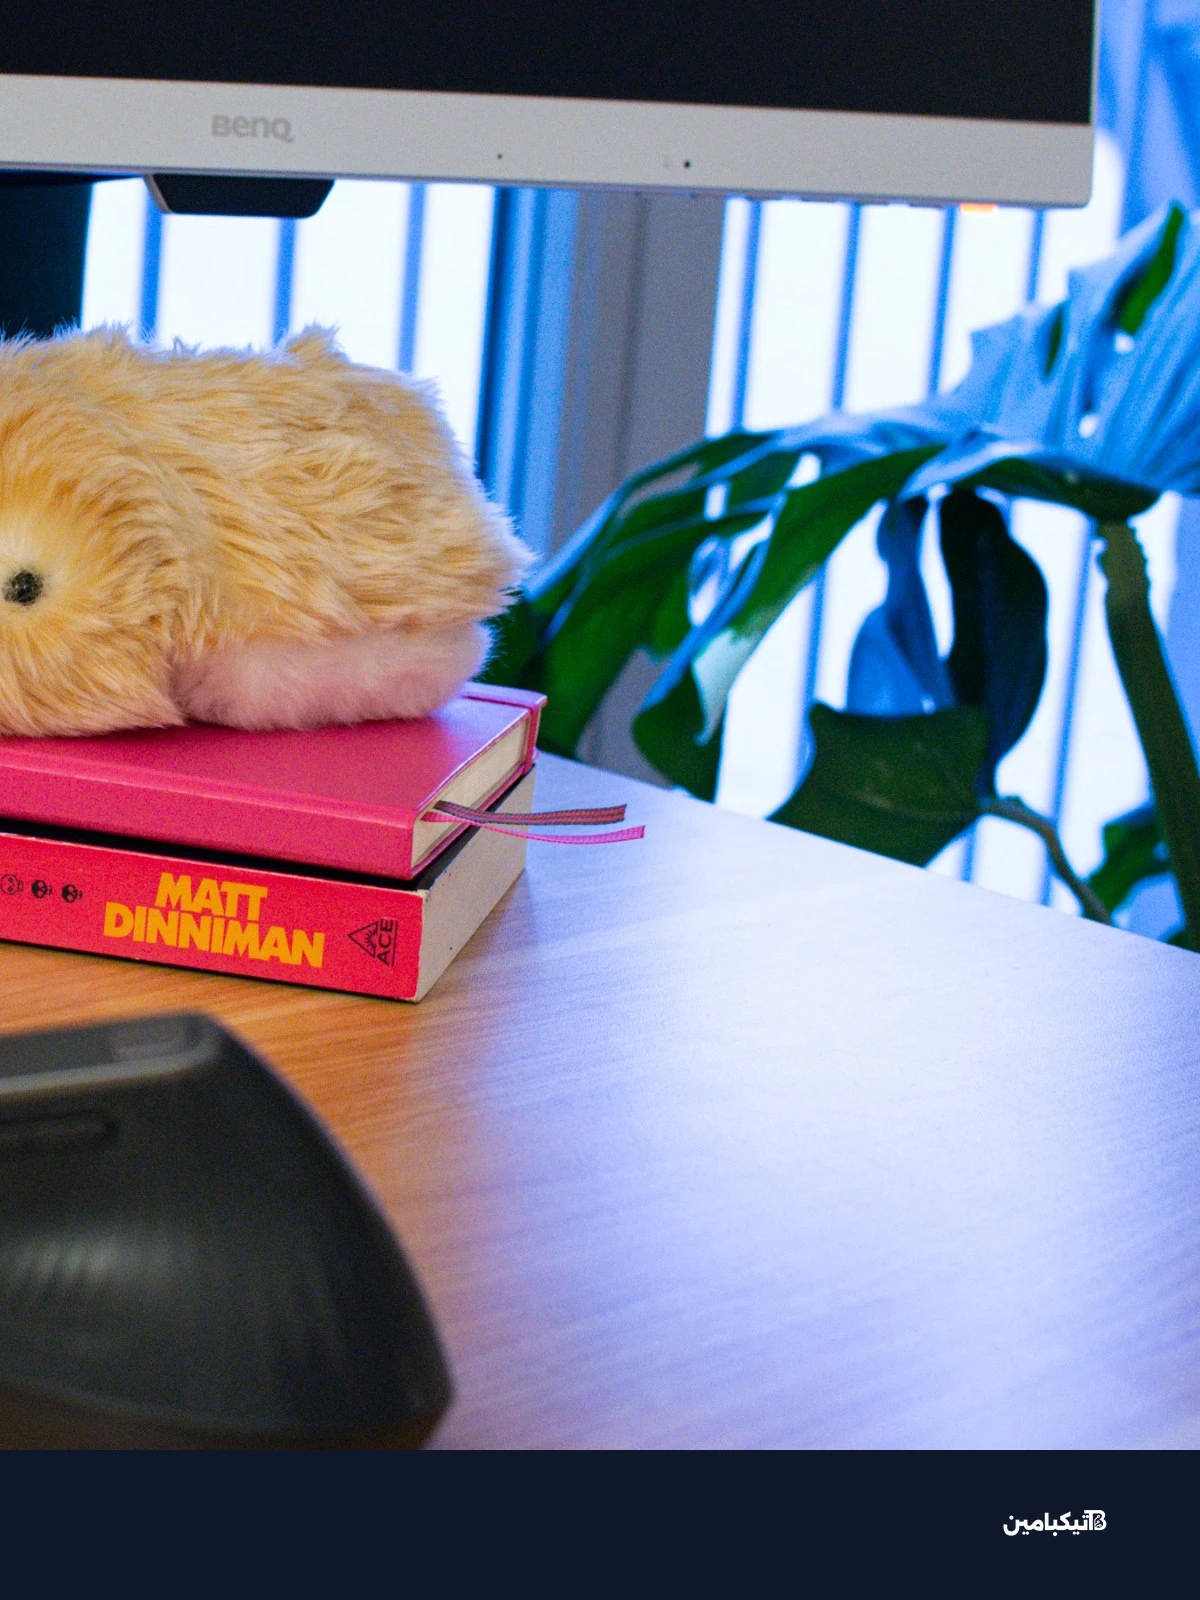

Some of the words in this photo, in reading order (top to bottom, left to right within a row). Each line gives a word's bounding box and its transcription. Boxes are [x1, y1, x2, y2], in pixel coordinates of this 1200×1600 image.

[211, 115, 294, 142] BenQ
[154, 871, 269, 921] MATT
[103, 901, 326, 969] DINNIMAN
[377, 919, 394, 967] ACE
